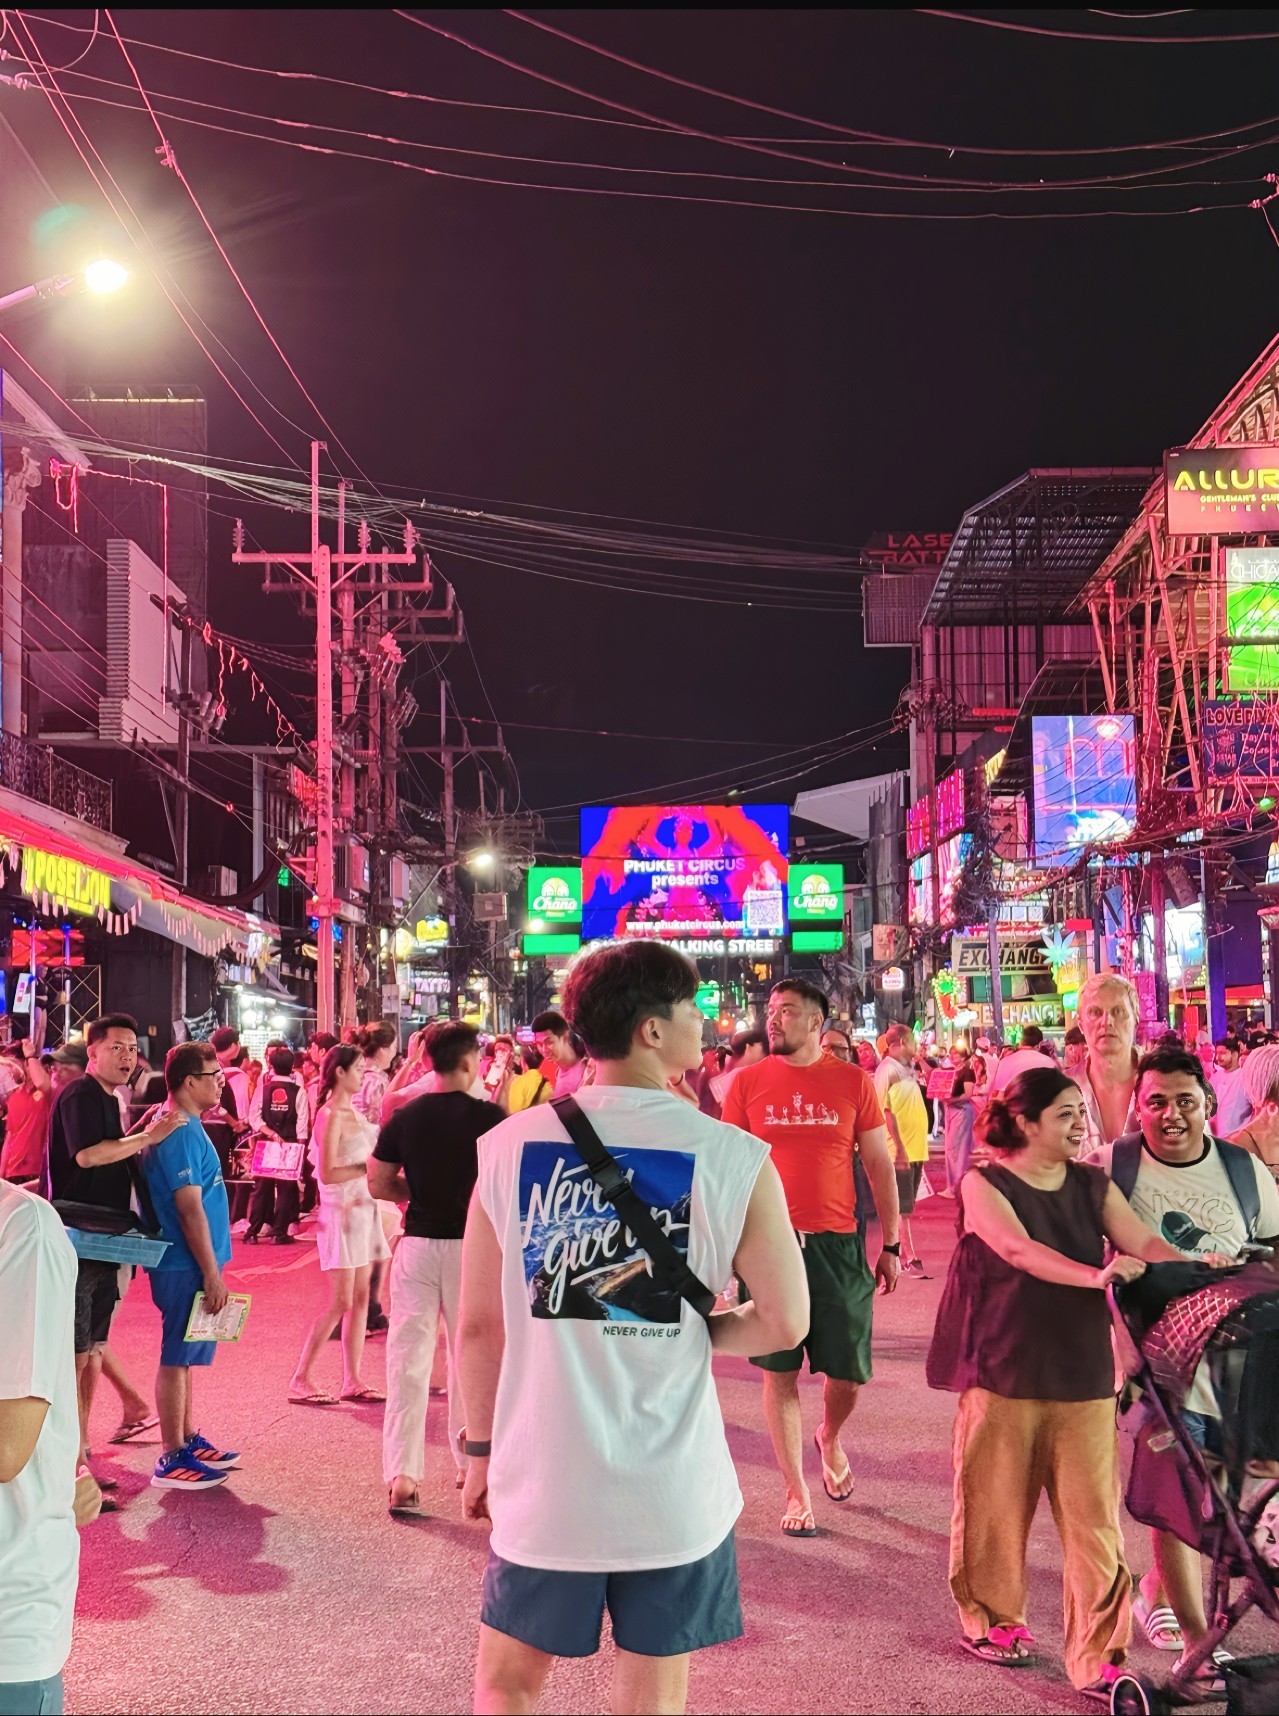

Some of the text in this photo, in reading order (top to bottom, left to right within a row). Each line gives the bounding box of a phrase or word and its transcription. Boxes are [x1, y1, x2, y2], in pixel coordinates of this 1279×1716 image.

[1200, 495, 1256, 503] GENTLEMAN'S
[1231, 563, 1279, 579] CHICA
[1206, 708, 1243, 726] LOVE
[624, 858, 745, 872] PHUKET CIRCUS
[652, 873, 718, 887] presents
[533, 896, 578, 914] Chang
[794, 894, 838, 911] Chang
[728, 939, 781, 953] STREET
[982, 1003, 1062, 1024] ECHANGE
[520, 1157, 635, 1250] Neve
[544, 1219, 620, 1314] give
[603, 1326, 681, 1338] NEVER GIVE UP
